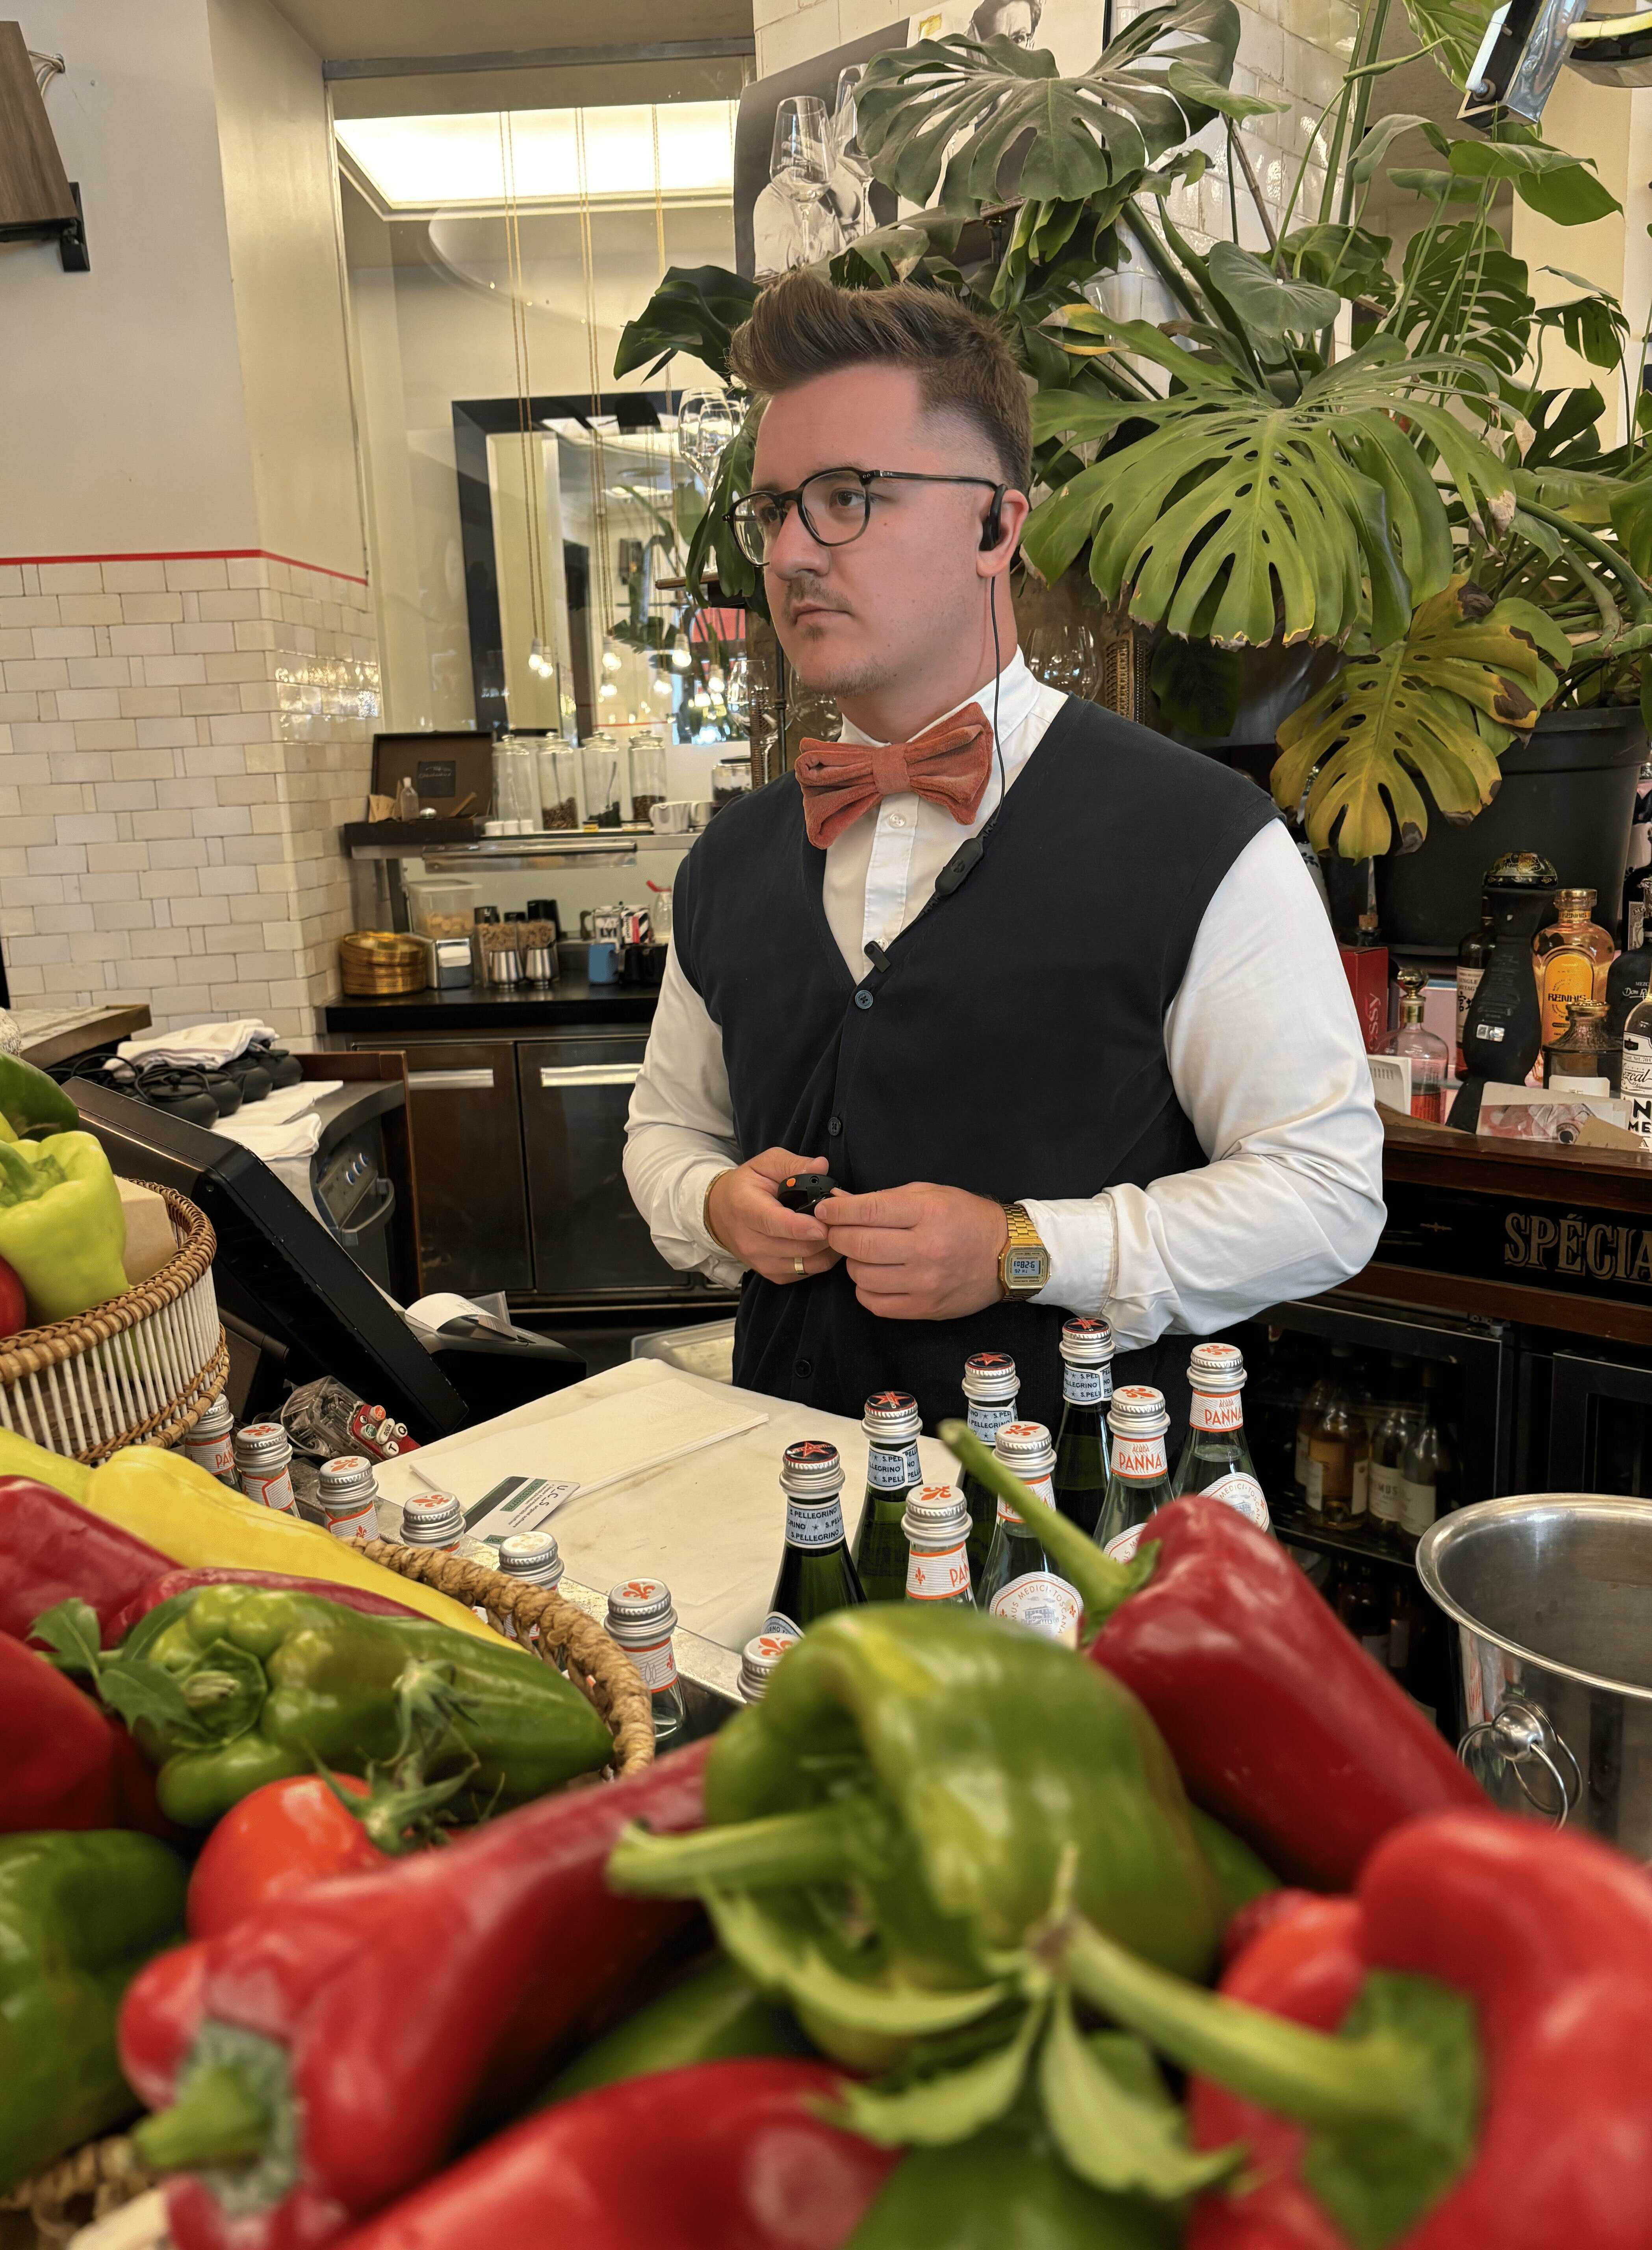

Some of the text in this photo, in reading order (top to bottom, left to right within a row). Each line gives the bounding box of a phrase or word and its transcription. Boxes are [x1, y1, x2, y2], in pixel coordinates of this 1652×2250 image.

[1204, 1405, 1242, 1425] PANNA
[383, 1424, 392, 1437] SODA
[398, 1426, 407, 1435] Q
[388, 1443, 397, 1452] T
[1118, 1451, 1162, 1471] PANNA
[1219, 1483, 1244, 1500] MEDICI
[1018, 1585, 1049, 1600] MEDICI
